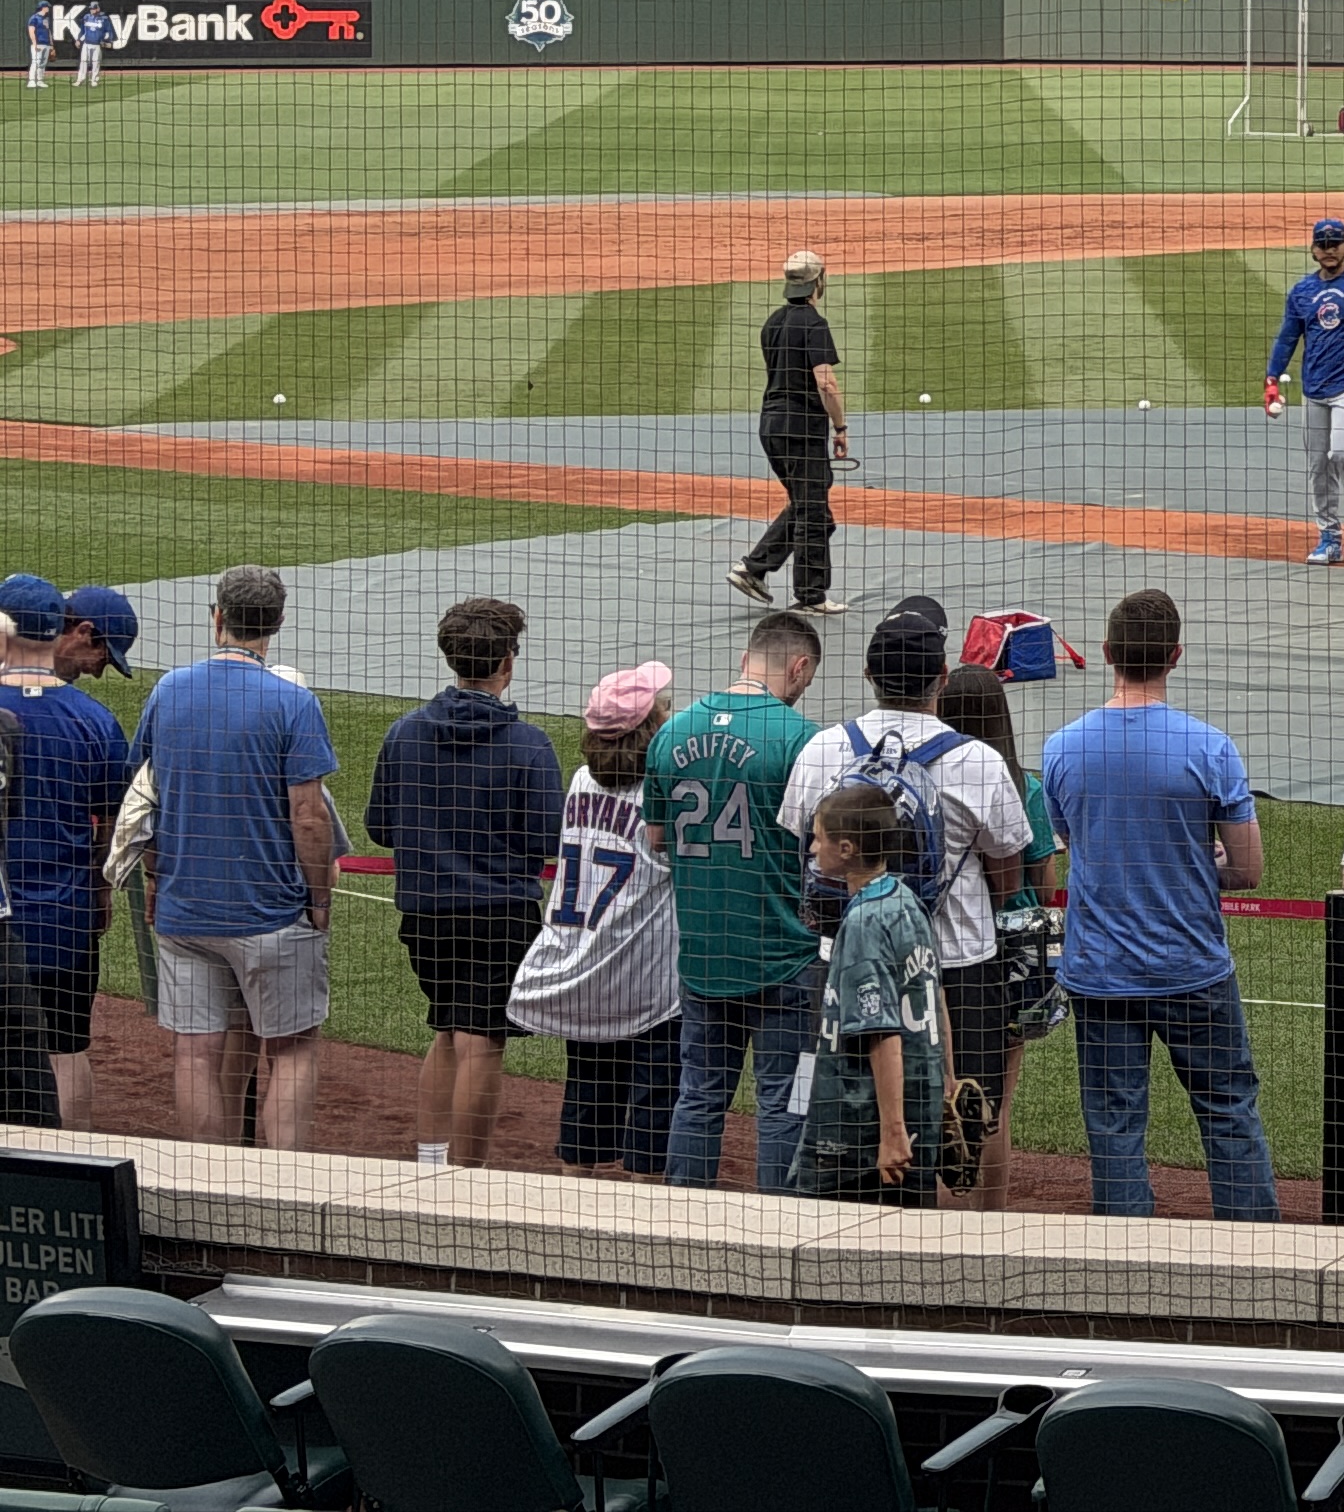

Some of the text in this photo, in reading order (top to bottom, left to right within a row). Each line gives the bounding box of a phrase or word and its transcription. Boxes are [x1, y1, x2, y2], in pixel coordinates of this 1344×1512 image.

[53, 5, 253, 42] KyBank
[520, 0, 561, 23] 50
[672, 733, 758, 769] GRIFFEY
[671, 779, 755, 859] 24
[551, 843, 636, 931] 17
